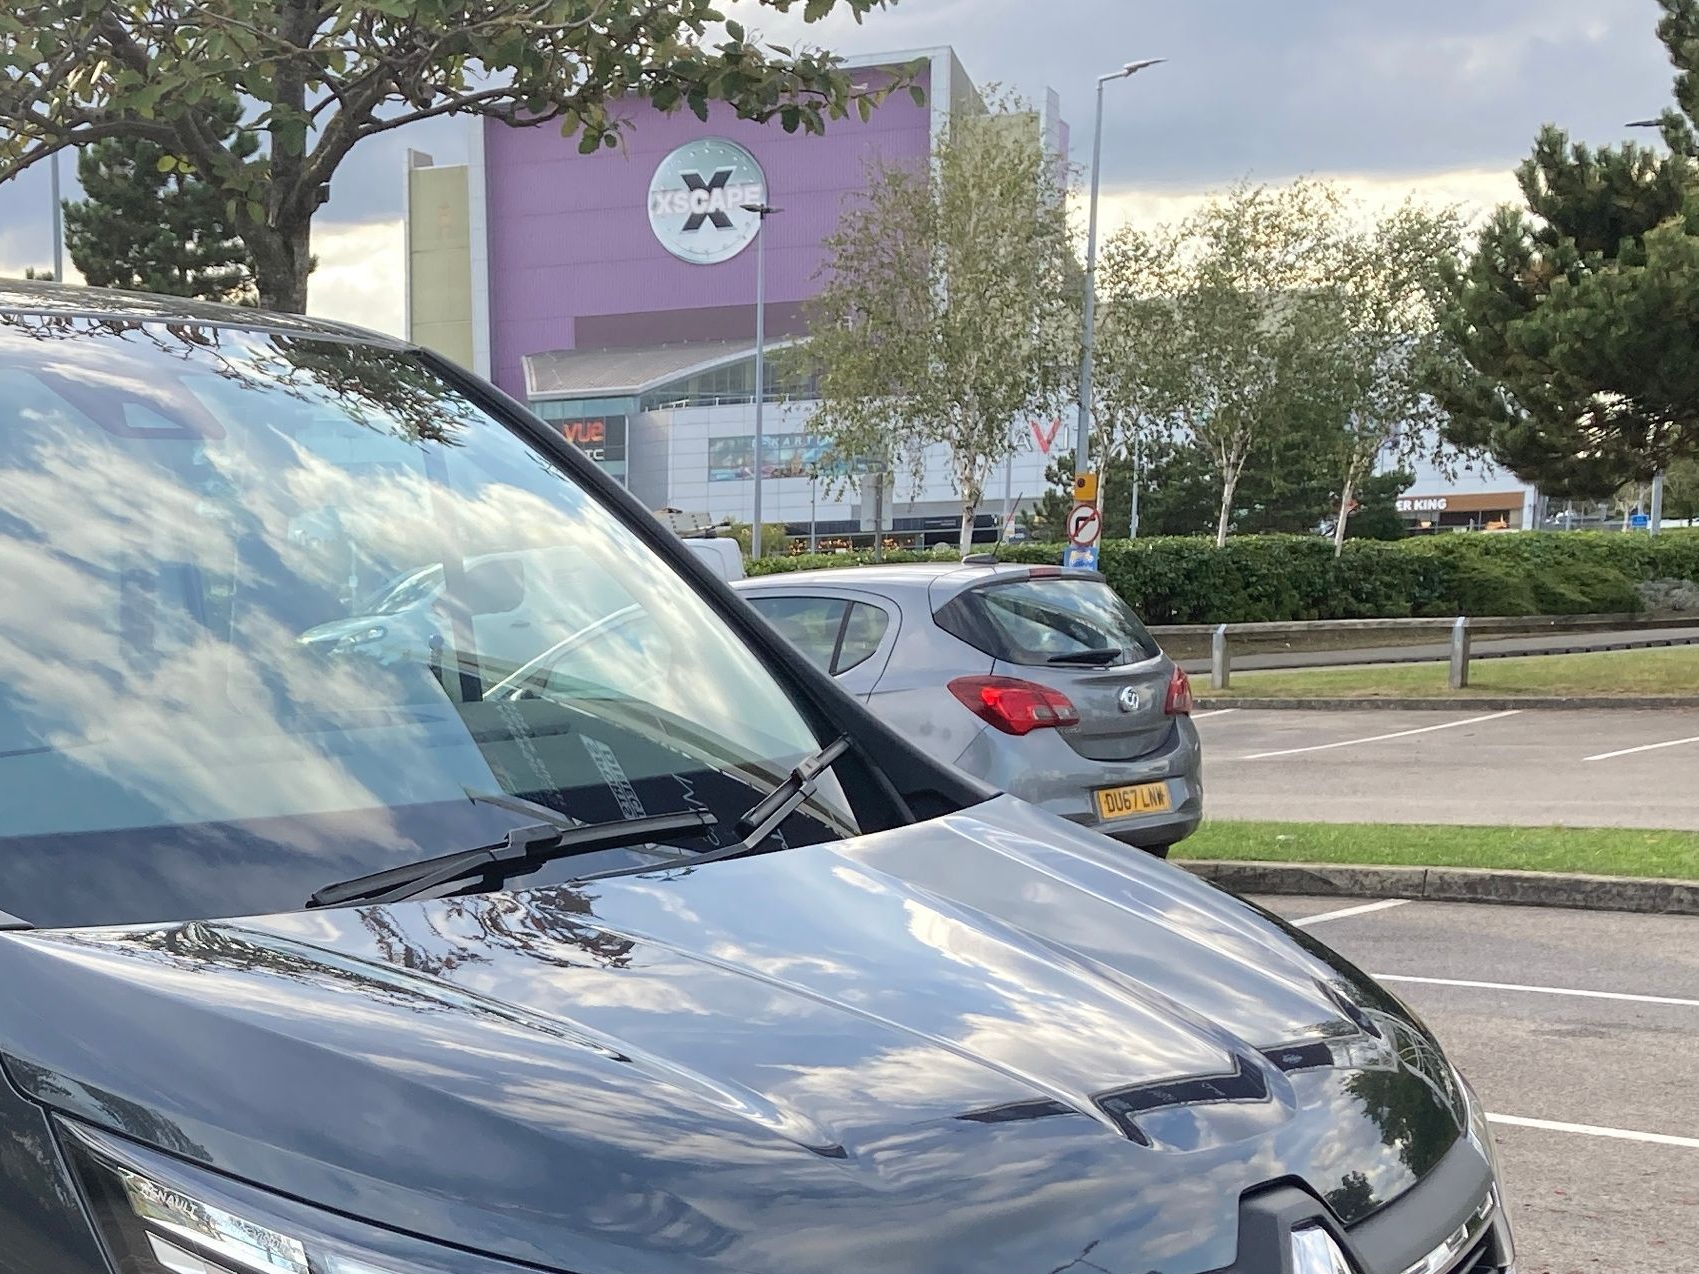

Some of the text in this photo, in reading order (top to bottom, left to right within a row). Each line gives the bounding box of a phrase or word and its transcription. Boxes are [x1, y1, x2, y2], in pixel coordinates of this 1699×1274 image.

[654, 183, 761, 215] XSCAPE
[1413, 498, 1447, 511] KING
[1104, 789, 1138, 813] DU67
[139, 1181, 199, 1216] RENAULT
